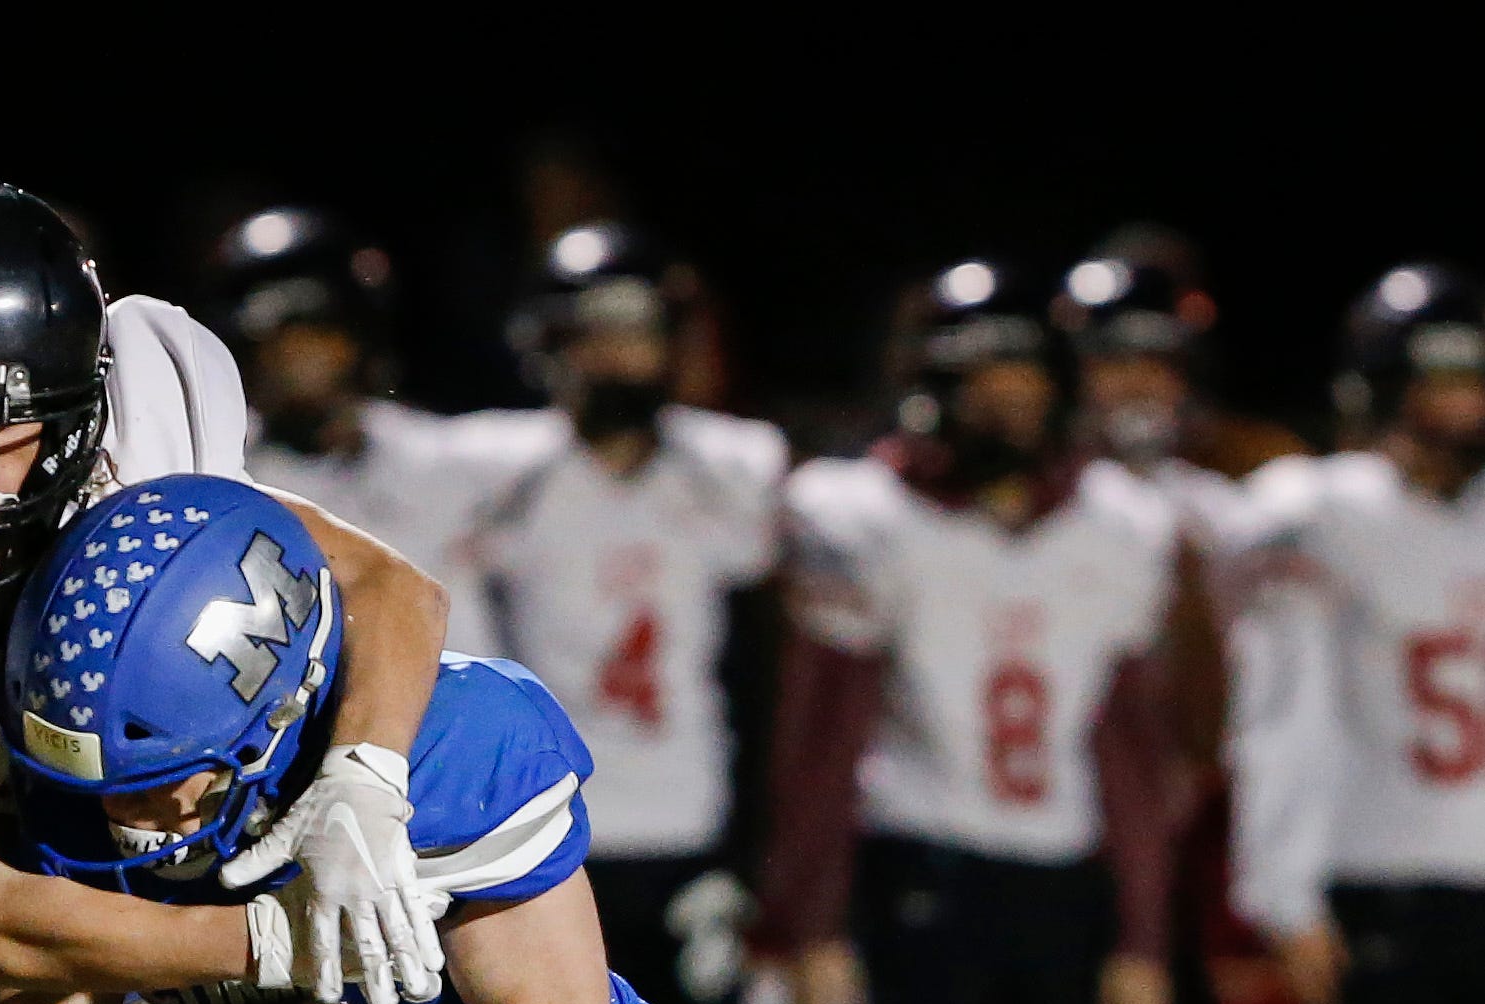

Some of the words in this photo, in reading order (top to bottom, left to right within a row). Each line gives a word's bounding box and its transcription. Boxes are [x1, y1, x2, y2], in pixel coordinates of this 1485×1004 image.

[185, 528, 318, 702] M
[594, 605, 662, 722] 4
[983, 657, 1049, 807] 8
